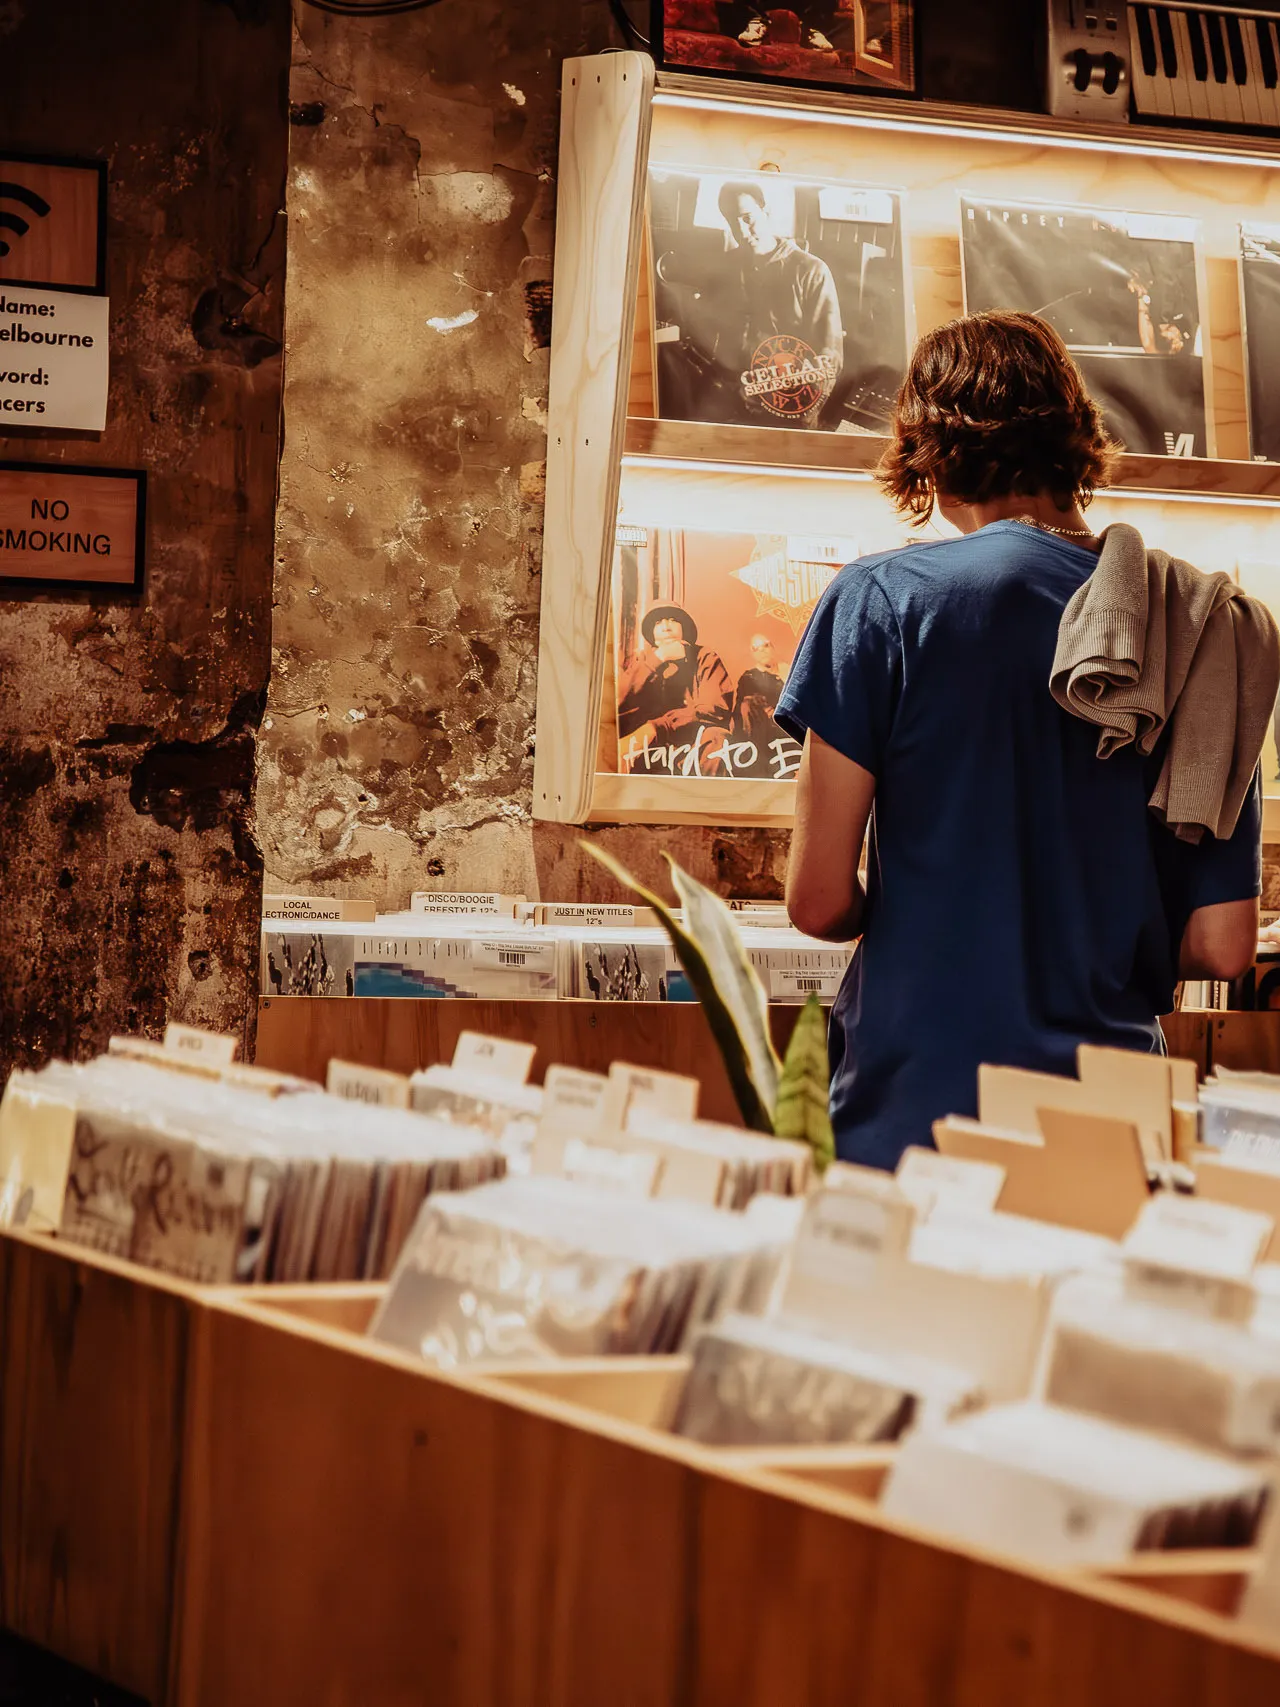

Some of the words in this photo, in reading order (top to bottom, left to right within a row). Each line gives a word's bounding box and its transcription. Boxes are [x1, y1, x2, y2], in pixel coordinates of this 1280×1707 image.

[0, 296, 55, 317] ame:
[740, 354, 836, 387] CELLAR
[744, 364, 837, 397] SELECTIONS
[0, 399, 46, 413] cers
[31, 498, 70, 521] NO
[623, 725, 704, 777] Hard
[707, 738, 758, 778] to
[283, 901, 312, 909] LOCAL
[428, 894, 495, 904] DISCO/BOOGIE
[262, 911, 341, 920] ECTRONIC/DANCE
[554, 908, 575, 917] JUST
[576, 908, 585, 917] IN
[586, 908, 605, 916] NEW
[606, 908, 633, 916] TITLES
